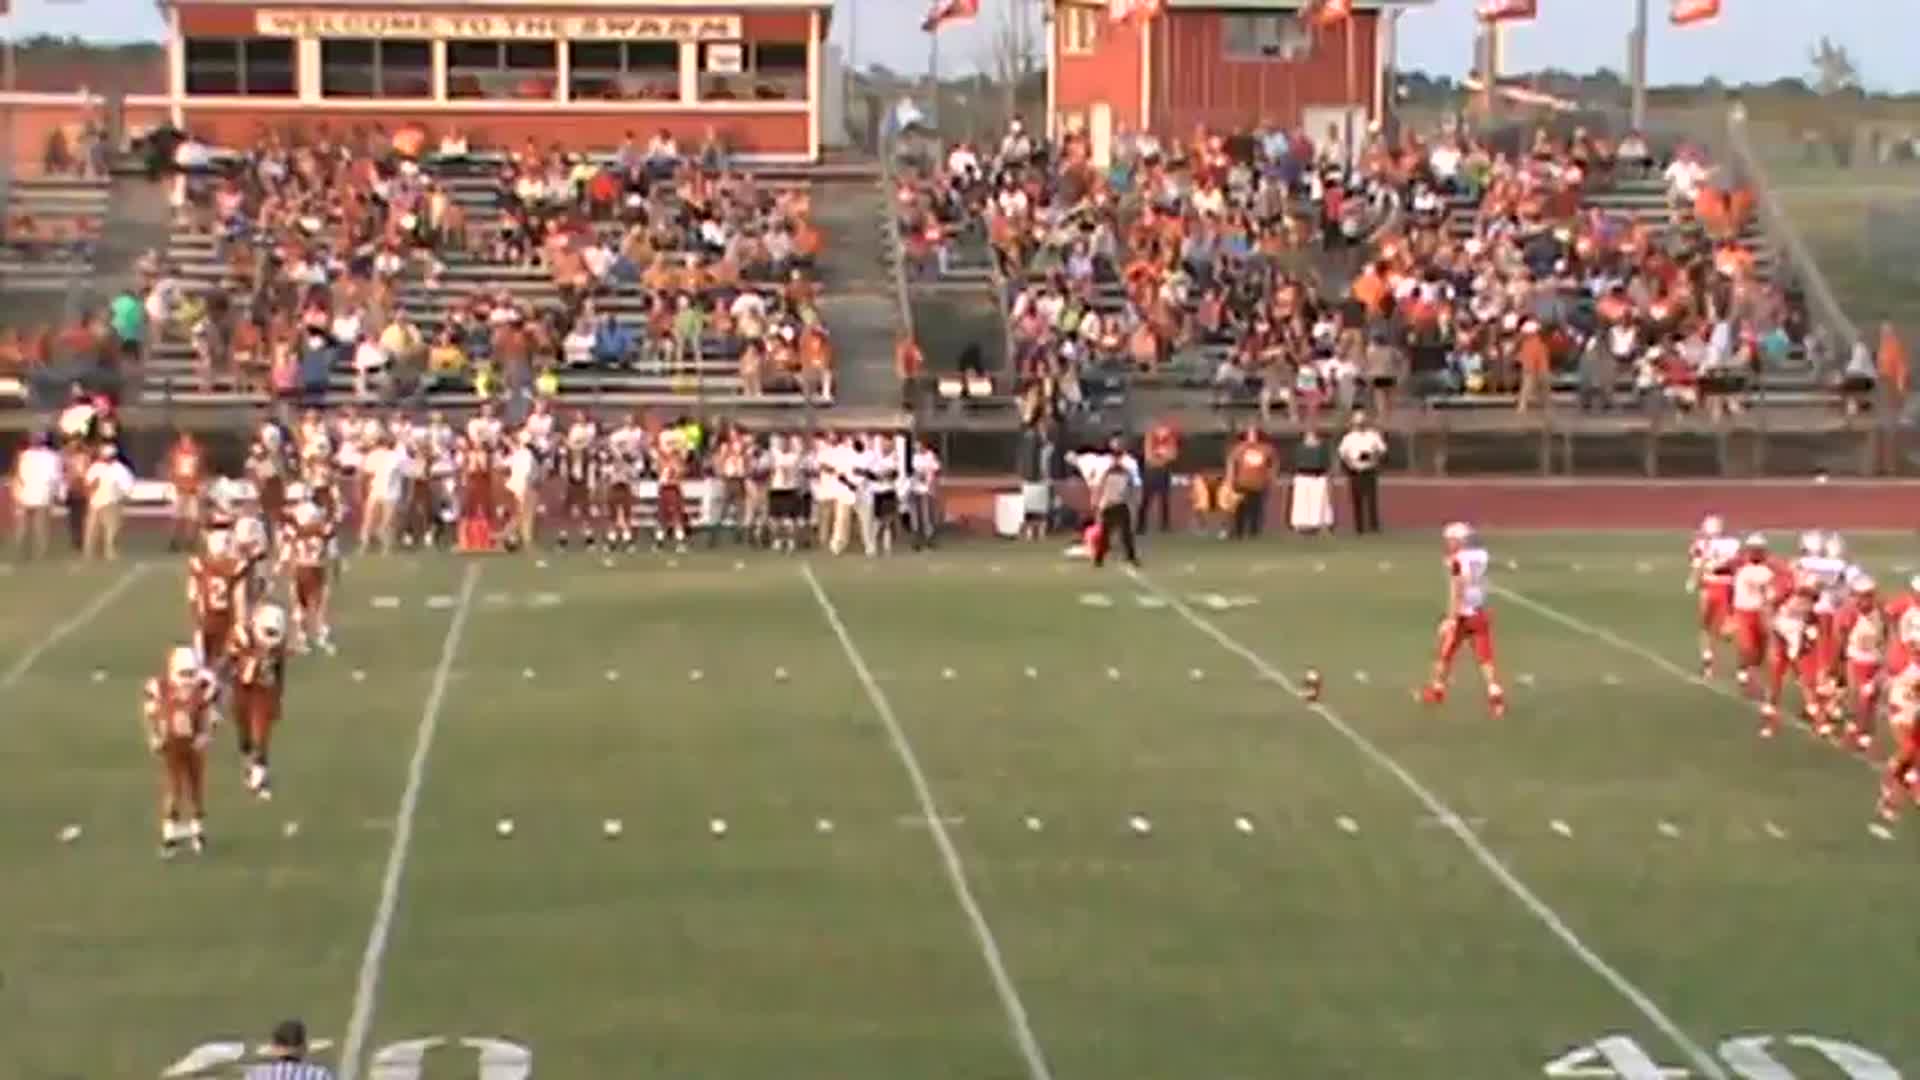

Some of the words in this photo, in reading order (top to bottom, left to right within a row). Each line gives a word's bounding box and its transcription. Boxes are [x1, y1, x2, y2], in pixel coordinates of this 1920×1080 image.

[268, 12, 431, 34] WELCOME
[449, 14, 493, 35] TO
[504, 15, 559, 36] THE
[578, 17, 731, 37] SWARM
